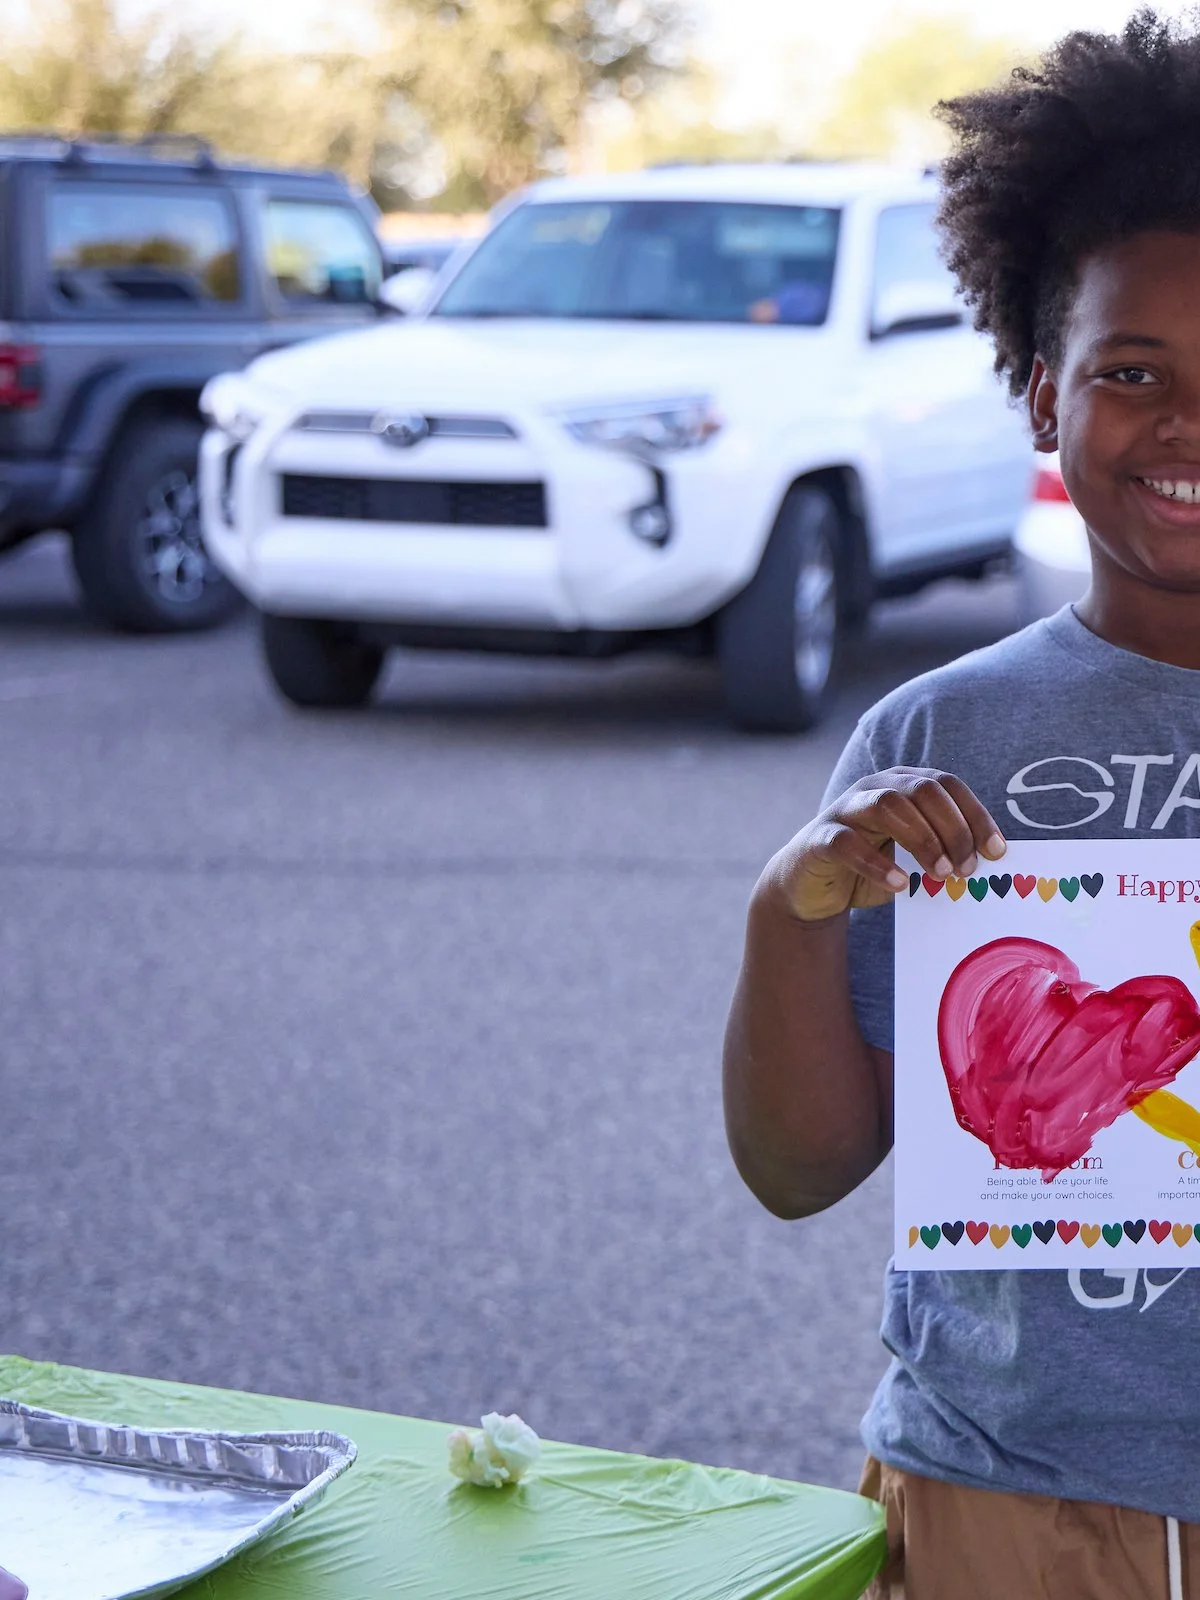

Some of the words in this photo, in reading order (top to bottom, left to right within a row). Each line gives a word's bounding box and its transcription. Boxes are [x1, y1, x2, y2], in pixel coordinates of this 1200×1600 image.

[992, 1152, 1104, 1171] Fredom
[986, 1176, 1014, 1188] Being
[1016, 1176, 1038, 1186] able
[1070, 1176, 1092, 1187] your
[1094, 1175, 1109, 1186] life
[1178, 1176, 1186, 1185] A
[980, 1191, 999, 1201] and
[1001, 1190, 1029, 1200] make
[1030, 1190, 1053, 1202] your
[1055, 1191, 1075, 1200] own
[1077, 1189, 1115, 1200] choices.
